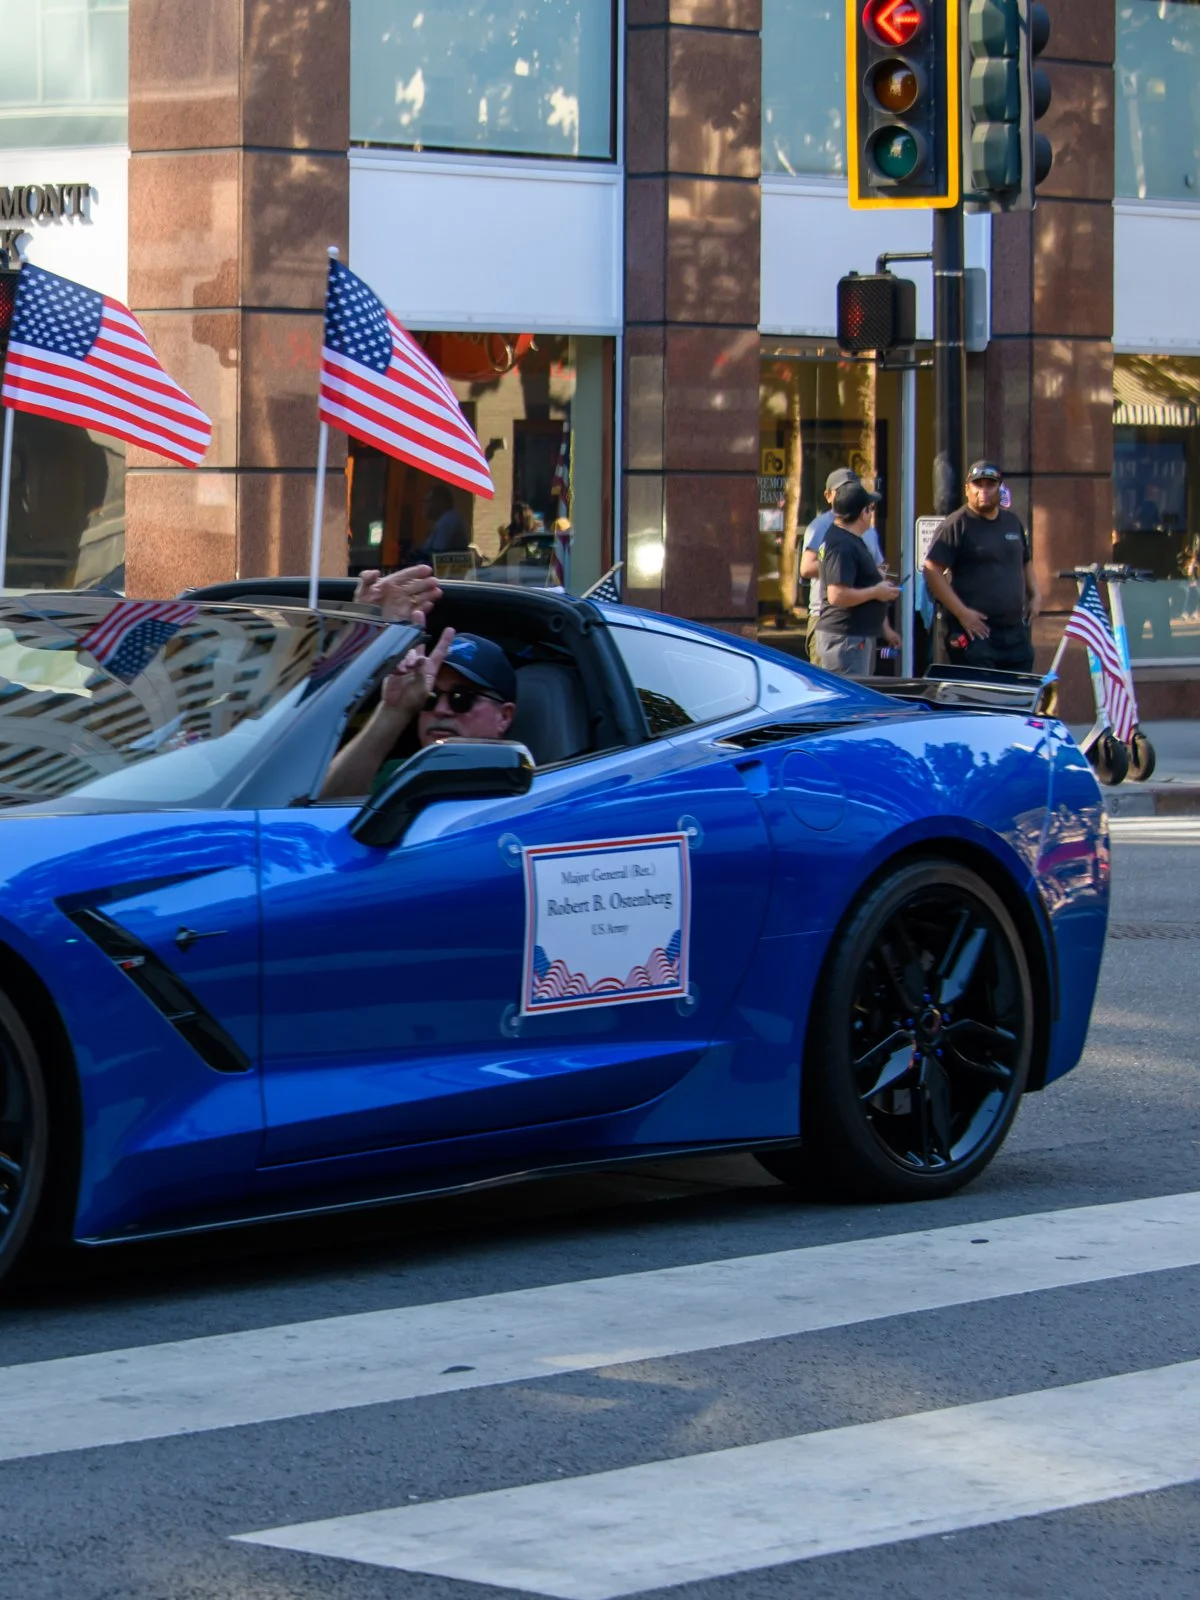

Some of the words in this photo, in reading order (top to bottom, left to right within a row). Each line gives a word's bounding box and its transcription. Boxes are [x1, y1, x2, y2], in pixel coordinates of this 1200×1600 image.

[561, 871, 590, 885] Major
[591, 865, 628, 881] General
[547, 897, 590, 916] Robert
[609, 889, 673, 909] Ostenberg
